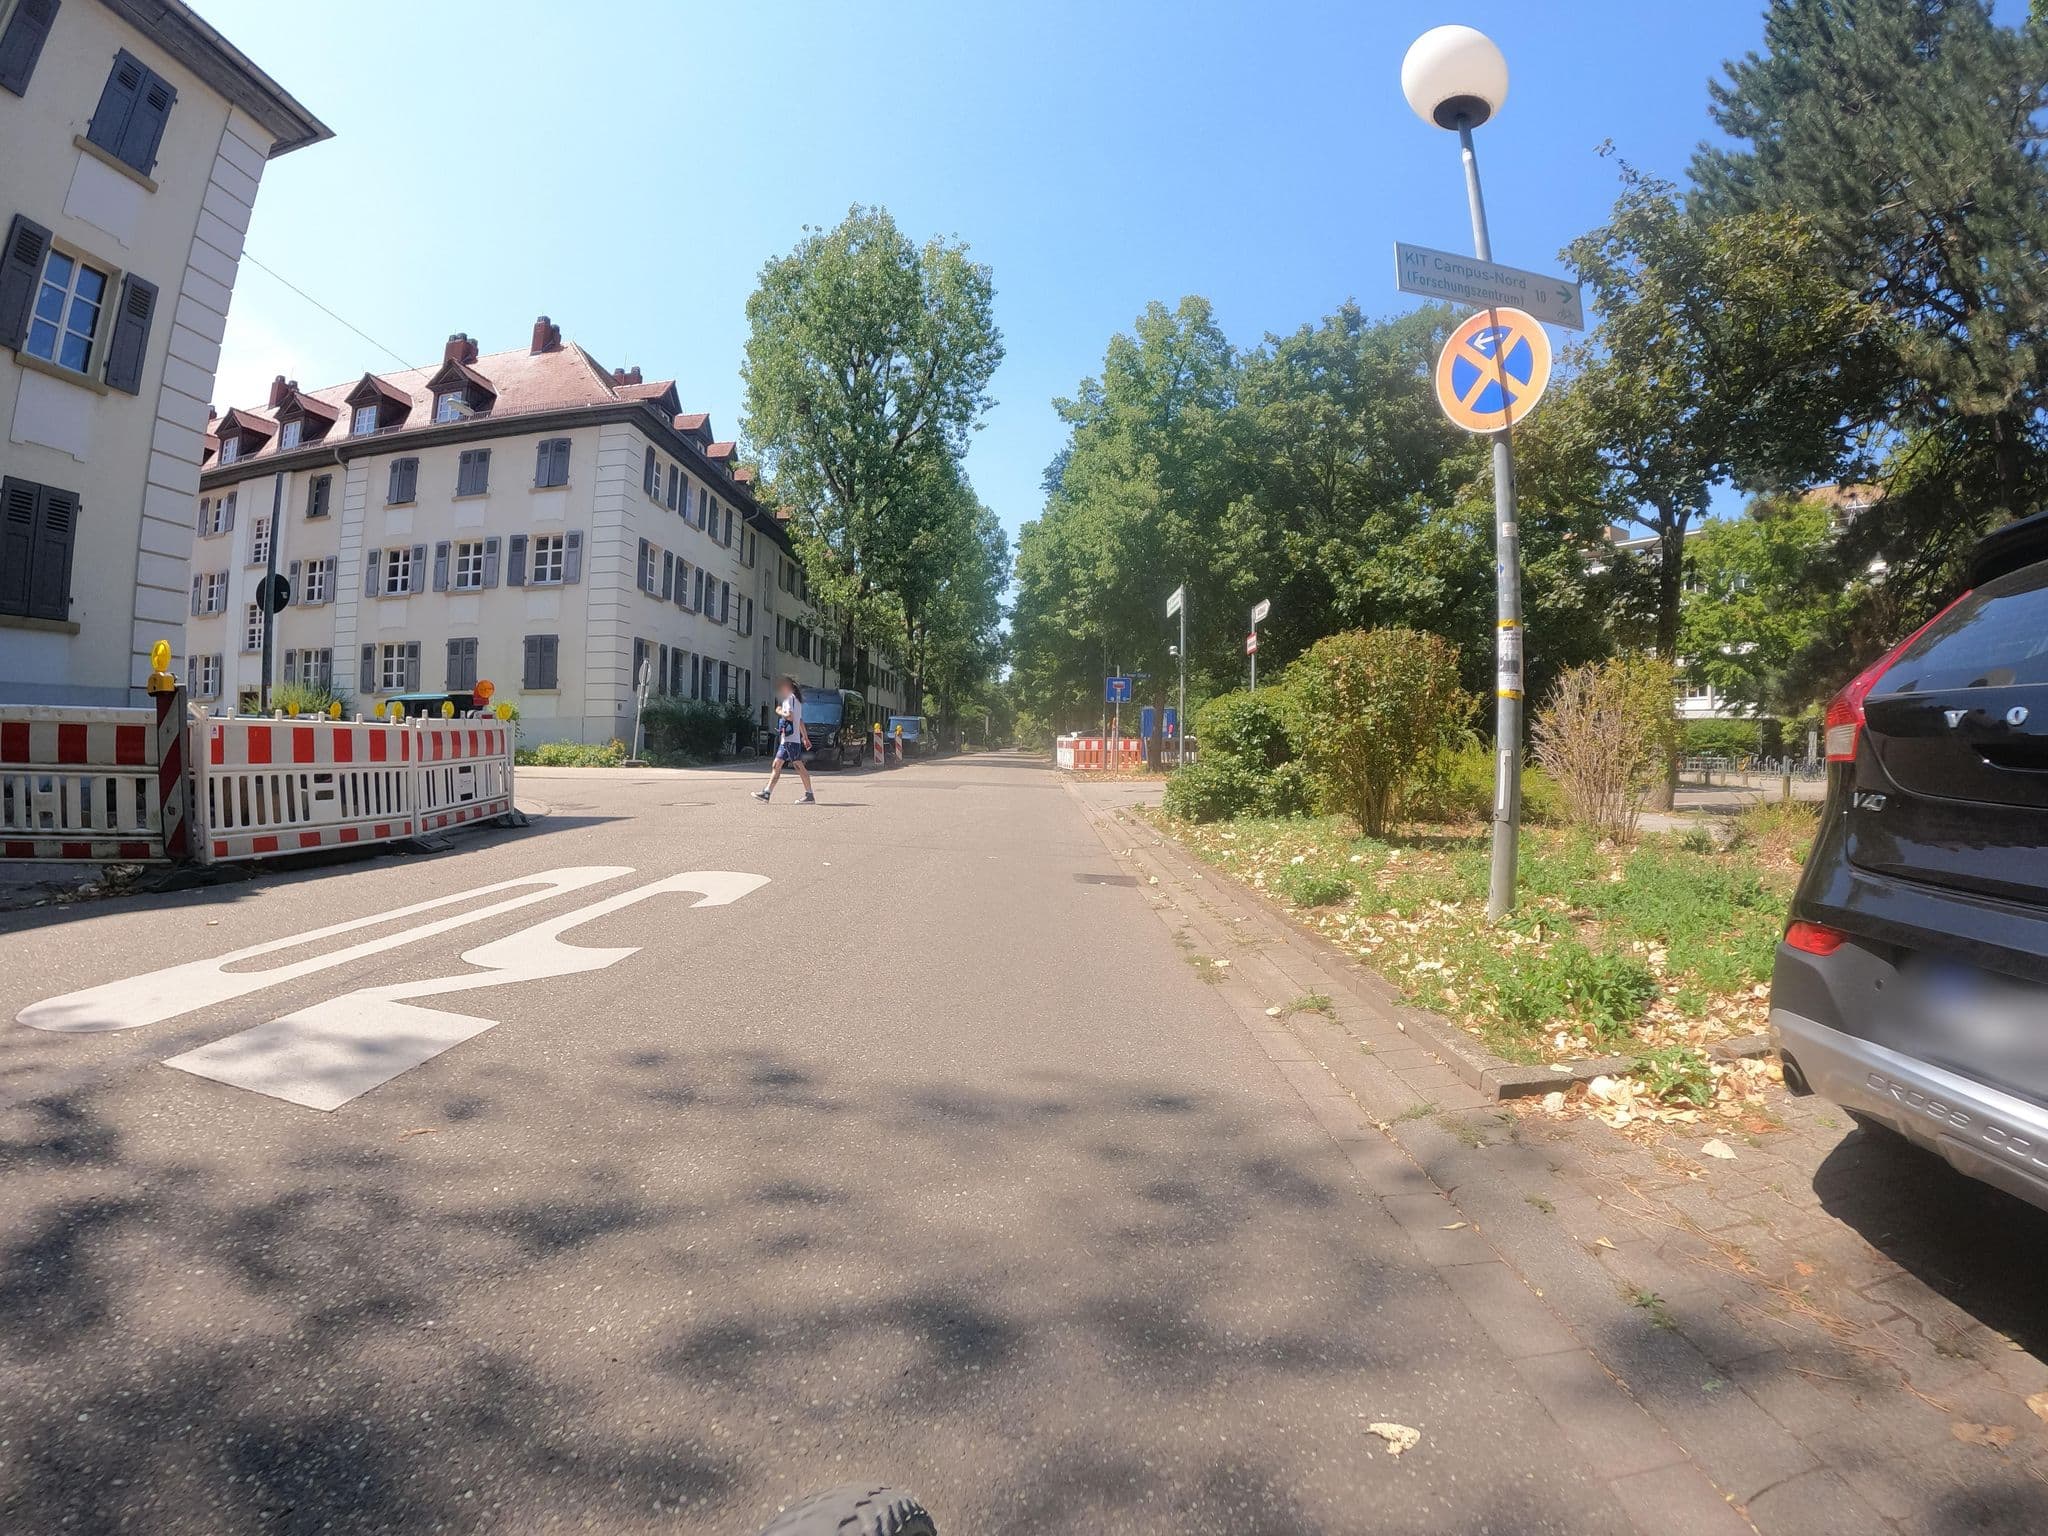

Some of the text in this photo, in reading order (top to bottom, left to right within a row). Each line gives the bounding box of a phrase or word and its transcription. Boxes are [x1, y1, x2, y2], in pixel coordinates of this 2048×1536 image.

[1405, 251, 1527, 289] KIT Campus-Nord
[1407, 270, 1525, 306] (Forschungszentrum)
[1853, 792, 1887, 812] V40
[1866, 1073, 1973, 1130] CROSS
